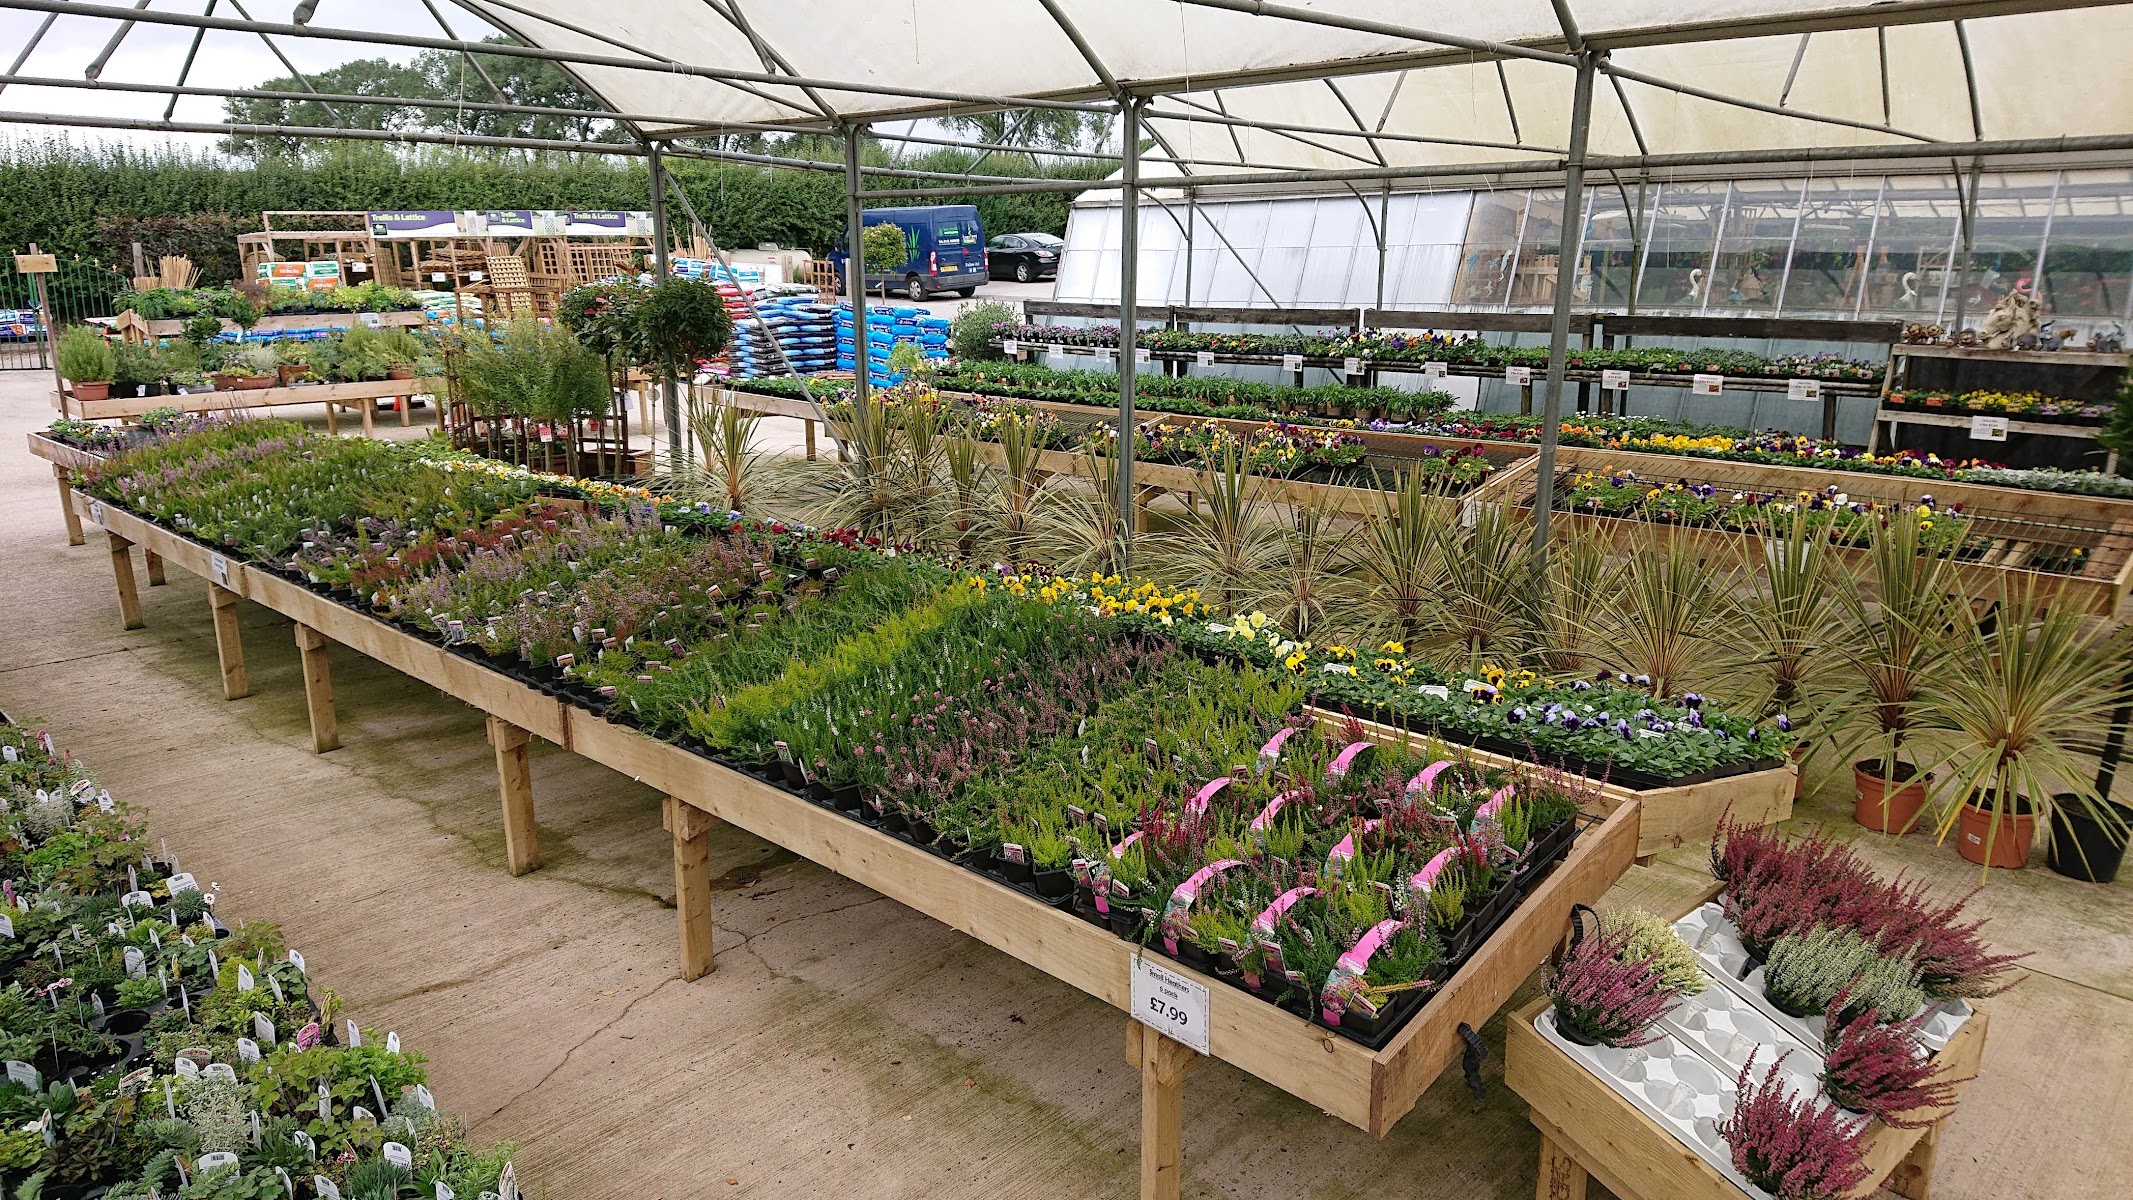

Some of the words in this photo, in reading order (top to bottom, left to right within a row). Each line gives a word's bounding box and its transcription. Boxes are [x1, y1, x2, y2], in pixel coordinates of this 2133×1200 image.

[1149, 969, 1164, 981] Small
[1165, 976, 1190, 993] Heathers
[1150, 996, 1188, 1025] £7.99
